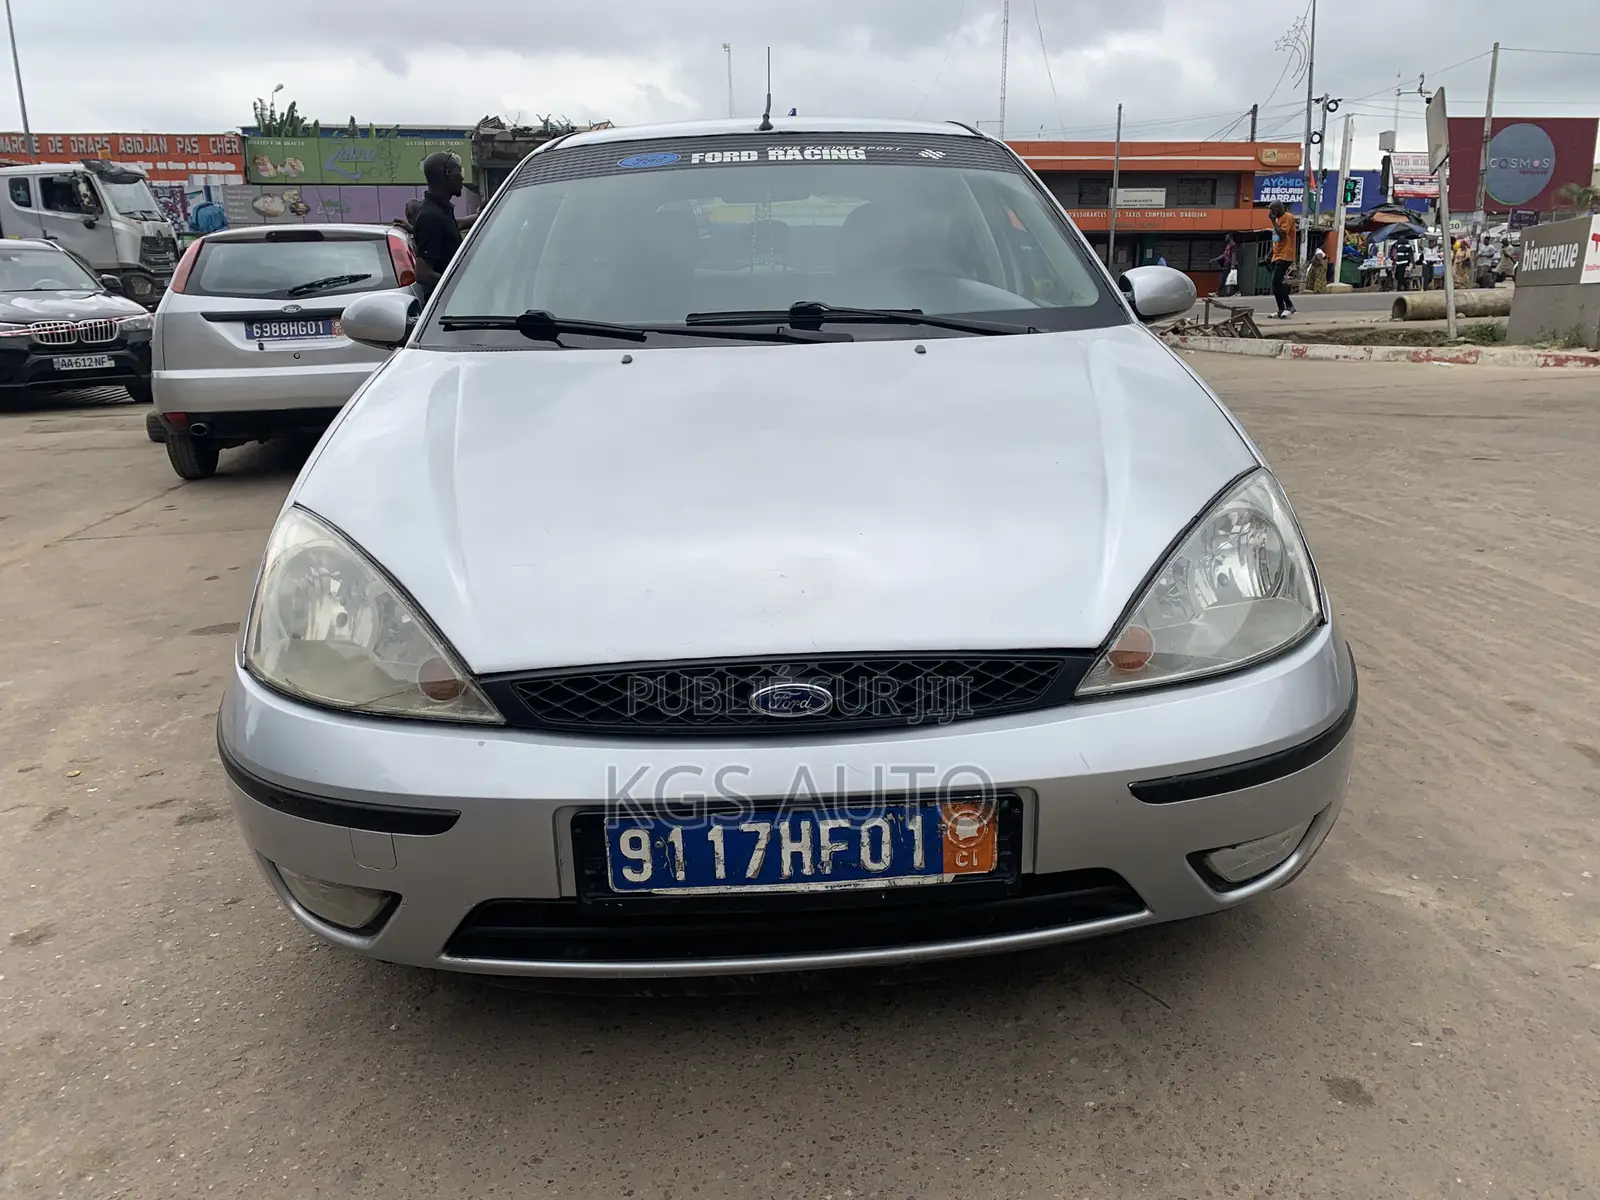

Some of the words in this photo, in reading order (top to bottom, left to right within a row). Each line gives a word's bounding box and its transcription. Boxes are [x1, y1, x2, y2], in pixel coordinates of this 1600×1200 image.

[0, 136, 40, 154] ARCE
[48, 136, 64, 154] DE
[70, 136, 111, 154] DRAPS
[119, 136, 168, 154] ABIDJAN
[177, 137, 200, 154] PAS
[209, 137, 240, 154] CHER
[632, 155, 668, 166] Ford
[690, 150, 759, 164] FORD
[768, 149, 867, 161] RACING
[1489, 157, 1551, 169] COSMOS
[1521, 240, 1579, 272] bienvenue
[252, 320, 325, 338] 6988HG01
[768, 690, 812, 710] Ford
[618, 813, 927, 884] 9117HF01
